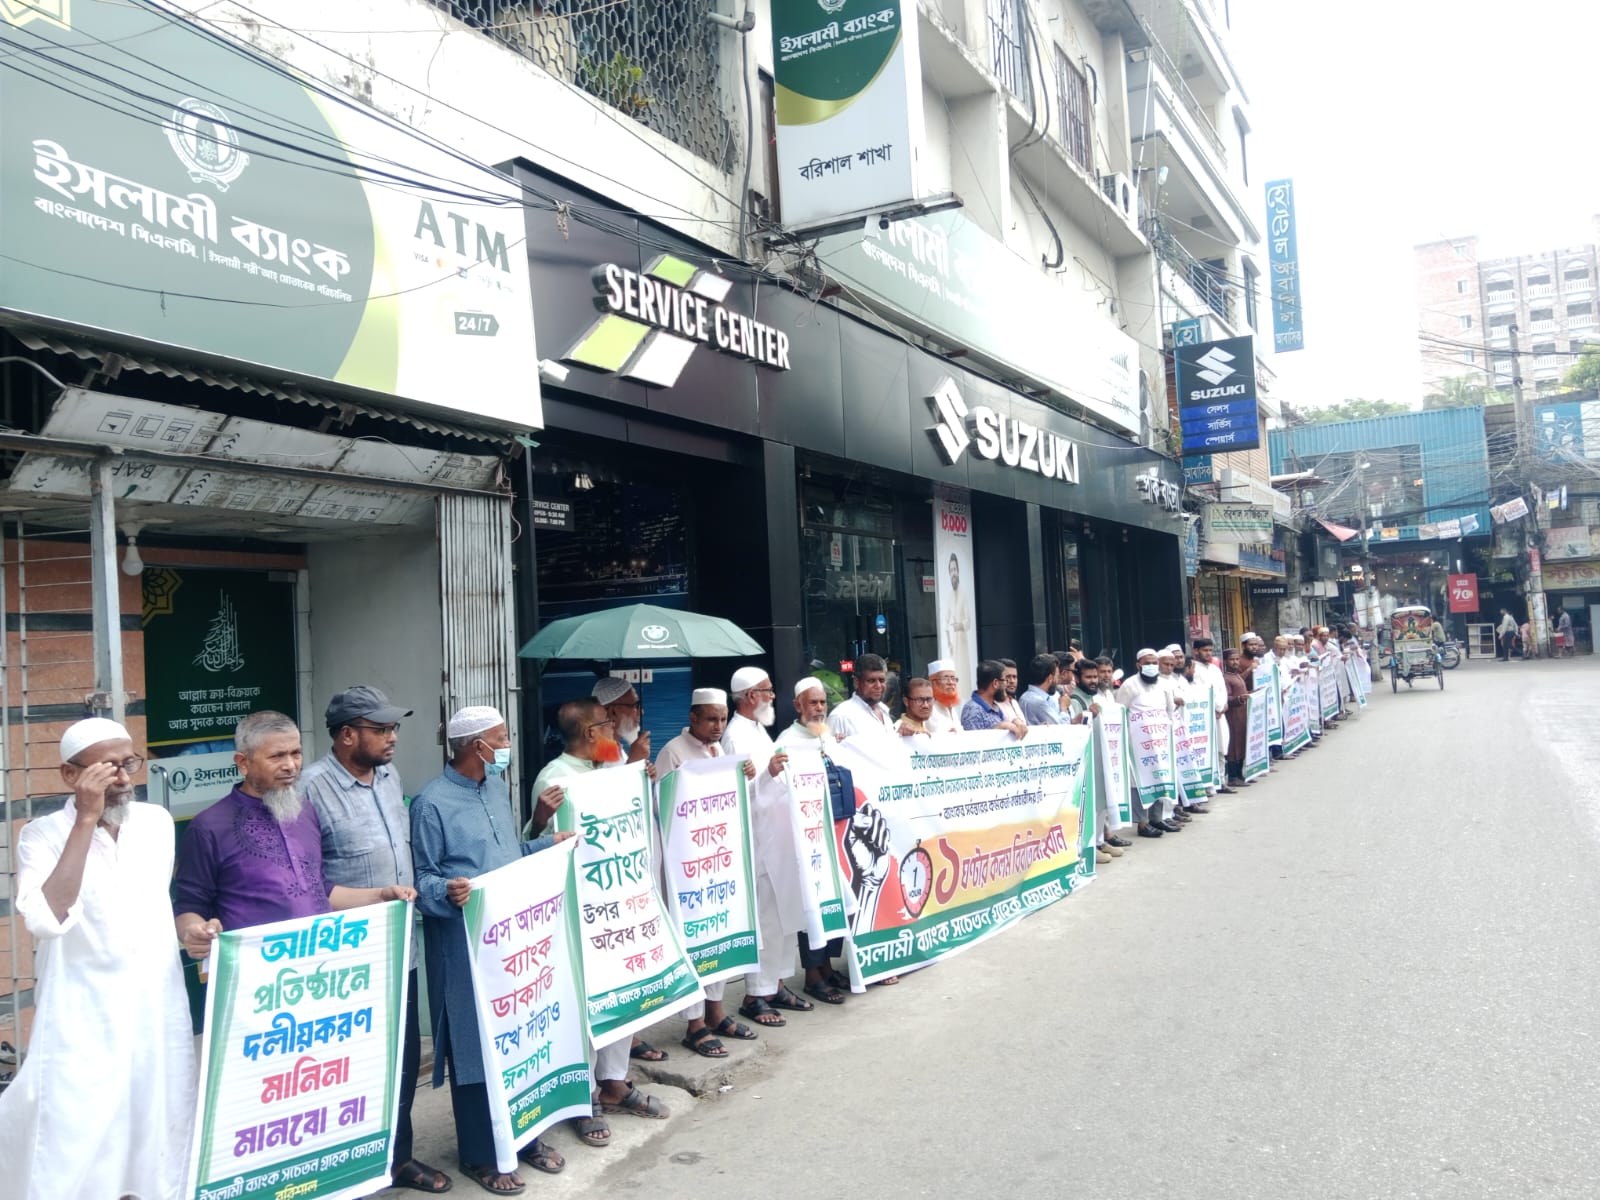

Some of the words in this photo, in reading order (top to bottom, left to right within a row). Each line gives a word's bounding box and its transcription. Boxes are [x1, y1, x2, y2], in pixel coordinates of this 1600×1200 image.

[780, 21, 839, 52] ইসলামী
[843, 10, 895, 33] ব্যাংক
[798, 154, 853, 181] বরিশাল
[856, 143, 893, 166] শাখা
[32, 139, 218, 244] ইসলামী
[230, 215, 352, 281] ব্যাংক
[34, 196, 125, 237] বাংলাদেশ
[1267, 181, 1291, 259] হোটেল
[414, 200, 511, 274] ATM
[457, 316, 492, 332] 24/7
[603, 263, 710, 342] SERVICE
[713, 306, 792, 370] CENTER
[1190, 384, 1246, 400] SUZUKI
[974, 406, 1080, 485] SUZUKI
[178, 690, 207, 702] আল্লাহ
[208, 686, 260, 700] ক্রয়-বিক্রয়কে
[190, 703, 223, 714] করেছেন
[225, 701, 251, 712] হালাল
[169, 719, 188, 730] আর
[190, 717, 214, 731] সুদকে
[194, 764, 239, 781] ইসলামী
[879, 785, 890, 802] এস
[892, 783, 913, 801] আলম
[914, 783, 919, 798] ও
[676, 799, 697, 820] এস
[700, 790, 737, 814] আলমের
[690, 822, 728, 848] ব্যাংক
[681, 845, 733, 879] ডাকাতি
[935, 838, 960, 905] ১
[990, 846, 1012, 882] কলম
[582, 901, 620, 924] উপর
[678, 888, 703, 910] রুখে
[706, 878, 736, 906] দাঁড়াও
[261, 915, 369, 963] আর্থিক
[483, 918, 511, 948] এস
[590, 926, 637, 952] অবৈধ
[683, 908, 730, 939] জনগণ
[855, 929, 914, 969] সলামী
[916, 922, 950, 952] ব্যাংক
[950, 908, 992, 937] সচেতন
[992, 895, 1022, 924] গ্রাহক
[1021, 878, 1069, 909] ফোরাম,
[501, 934, 553, 979] ব্যাংক
[623, 953, 646, 974] বন্ধ
[253, 961, 371, 1014] প্রতিষ্ঠানে
[490, 965, 556, 1020] ডাকাতি
[586, 991, 618, 1016] ইসলামী
[618, 987, 641, 1006] ব্যাংক
[242, 1007, 373, 1061] দলীয়করণ
[525, 1000, 560, 1043] দাঁড়াও
[260, 1056, 350, 1105] মানিনা
[502, 1040, 553, 1091] জনগণ
[517, 1087, 539, 1112] সচেতন
[540, 1075, 559, 1098] গ্রাহক
[560, 1070, 590, 1086] ফোরাম
[233, 1106, 328, 1158] মানবো
[338, 1096, 367, 1127] না
[245, 1170, 279, 1192] ব্যাংক
[281, 1158, 318, 1182] সচেতন
[320, 1150, 350, 1172] গ্রাহক
[350, 1138, 386, 1161] ফোরাম
[275, 1179, 318, 1200] বরিশাল
